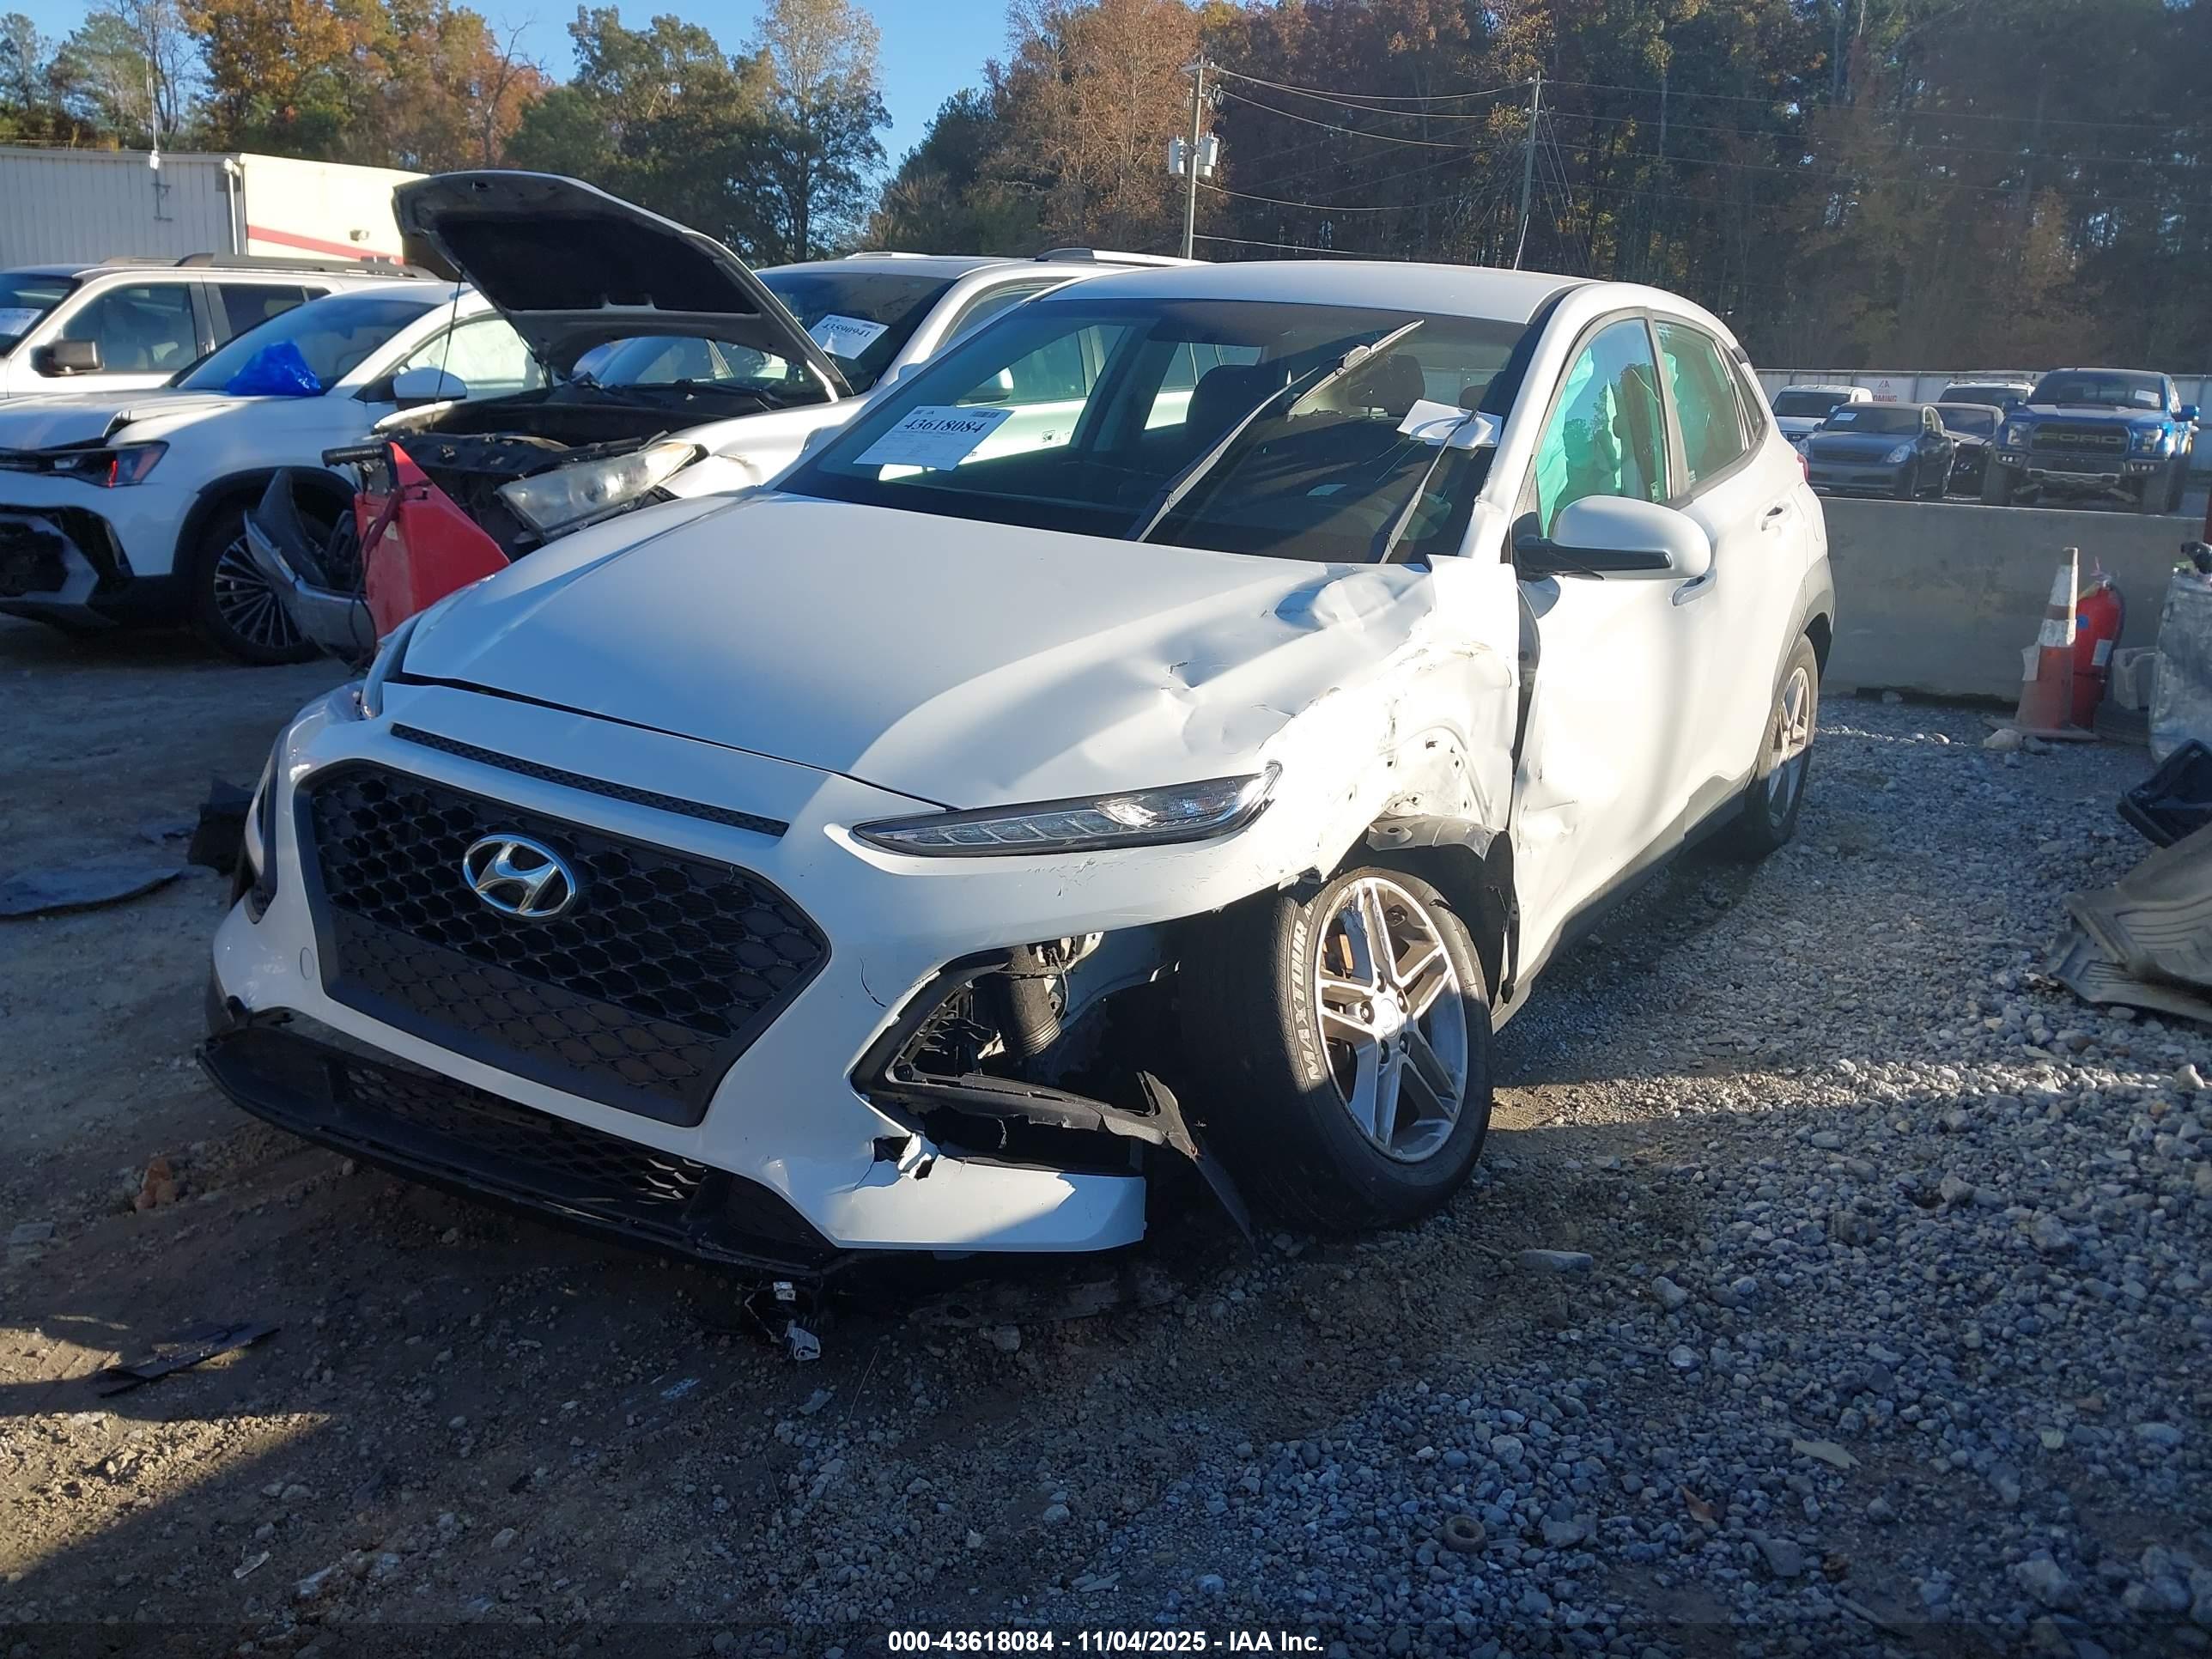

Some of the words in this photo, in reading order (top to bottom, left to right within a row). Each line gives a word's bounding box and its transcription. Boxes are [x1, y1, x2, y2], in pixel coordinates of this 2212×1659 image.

[904, 418, 988, 434] 43618084
[2036, 432, 2125, 444] FORD
[1291, 920, 1321, 1080] MAXTOUR
